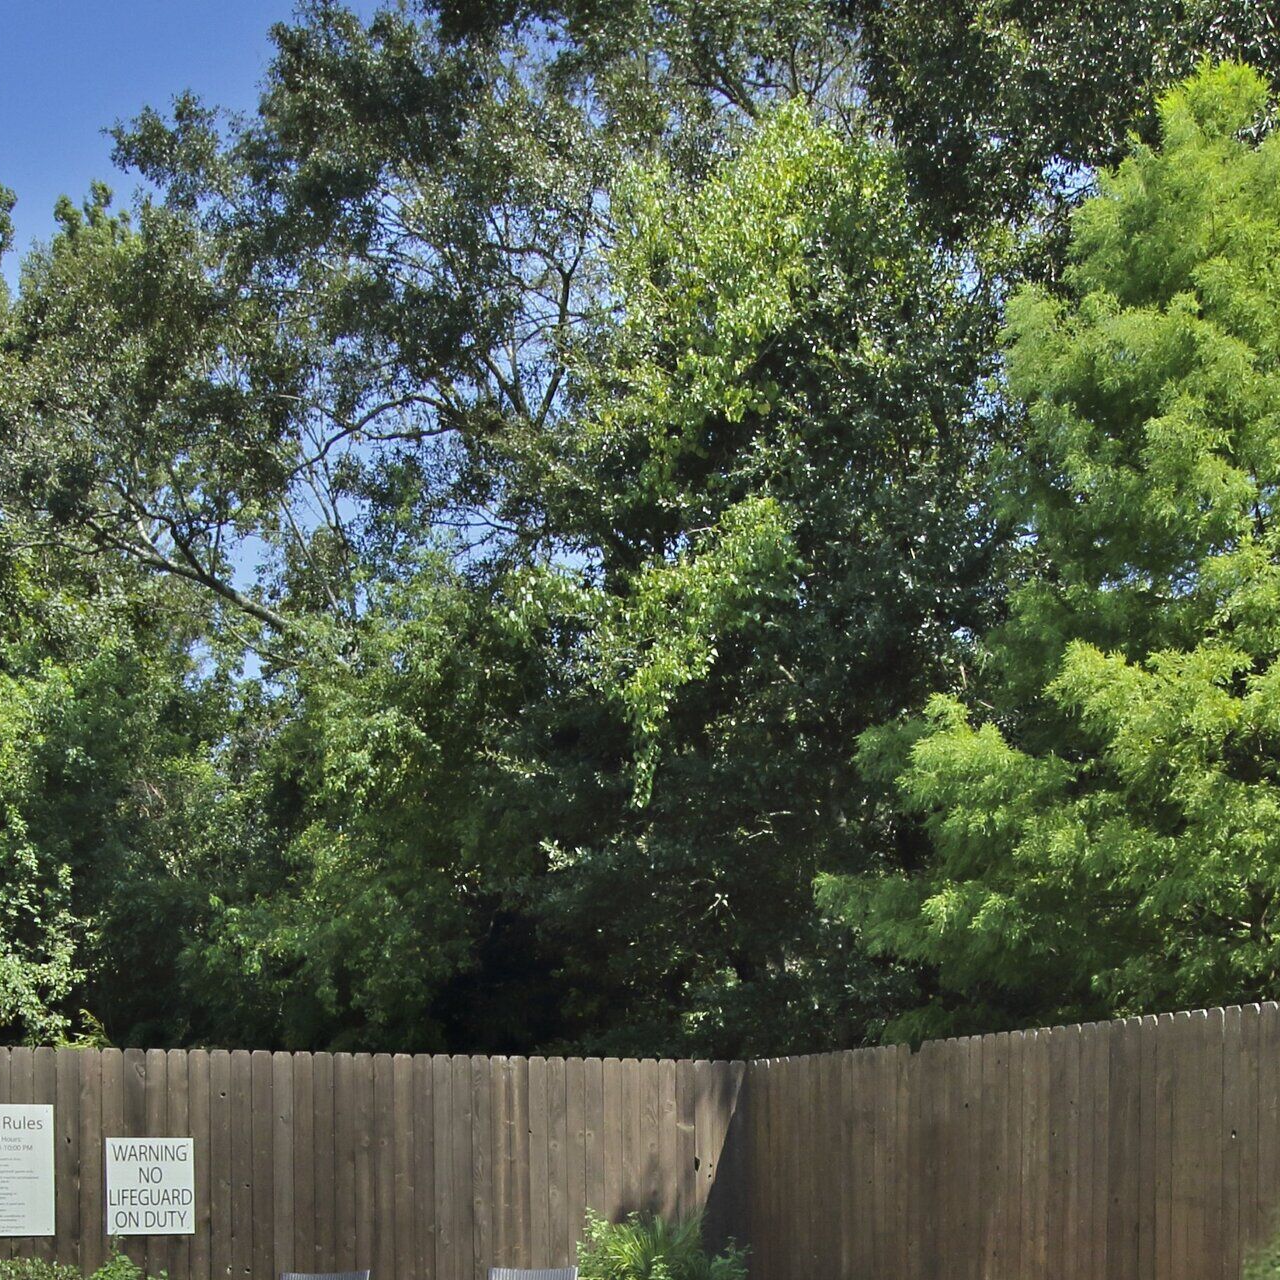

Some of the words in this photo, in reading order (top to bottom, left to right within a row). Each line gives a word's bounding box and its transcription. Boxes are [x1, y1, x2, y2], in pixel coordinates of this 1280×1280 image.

[2, 1115, 43, 1130] Rules
[111, 1144, 187, 1161] WARNING
[138, 1166, 163, 1184] NO
[109, 1188, 193, 1206] LIFEGUARD
[115, 1210, 139, 1228] ON
[144, 1210, 187, 1228] DUTY
